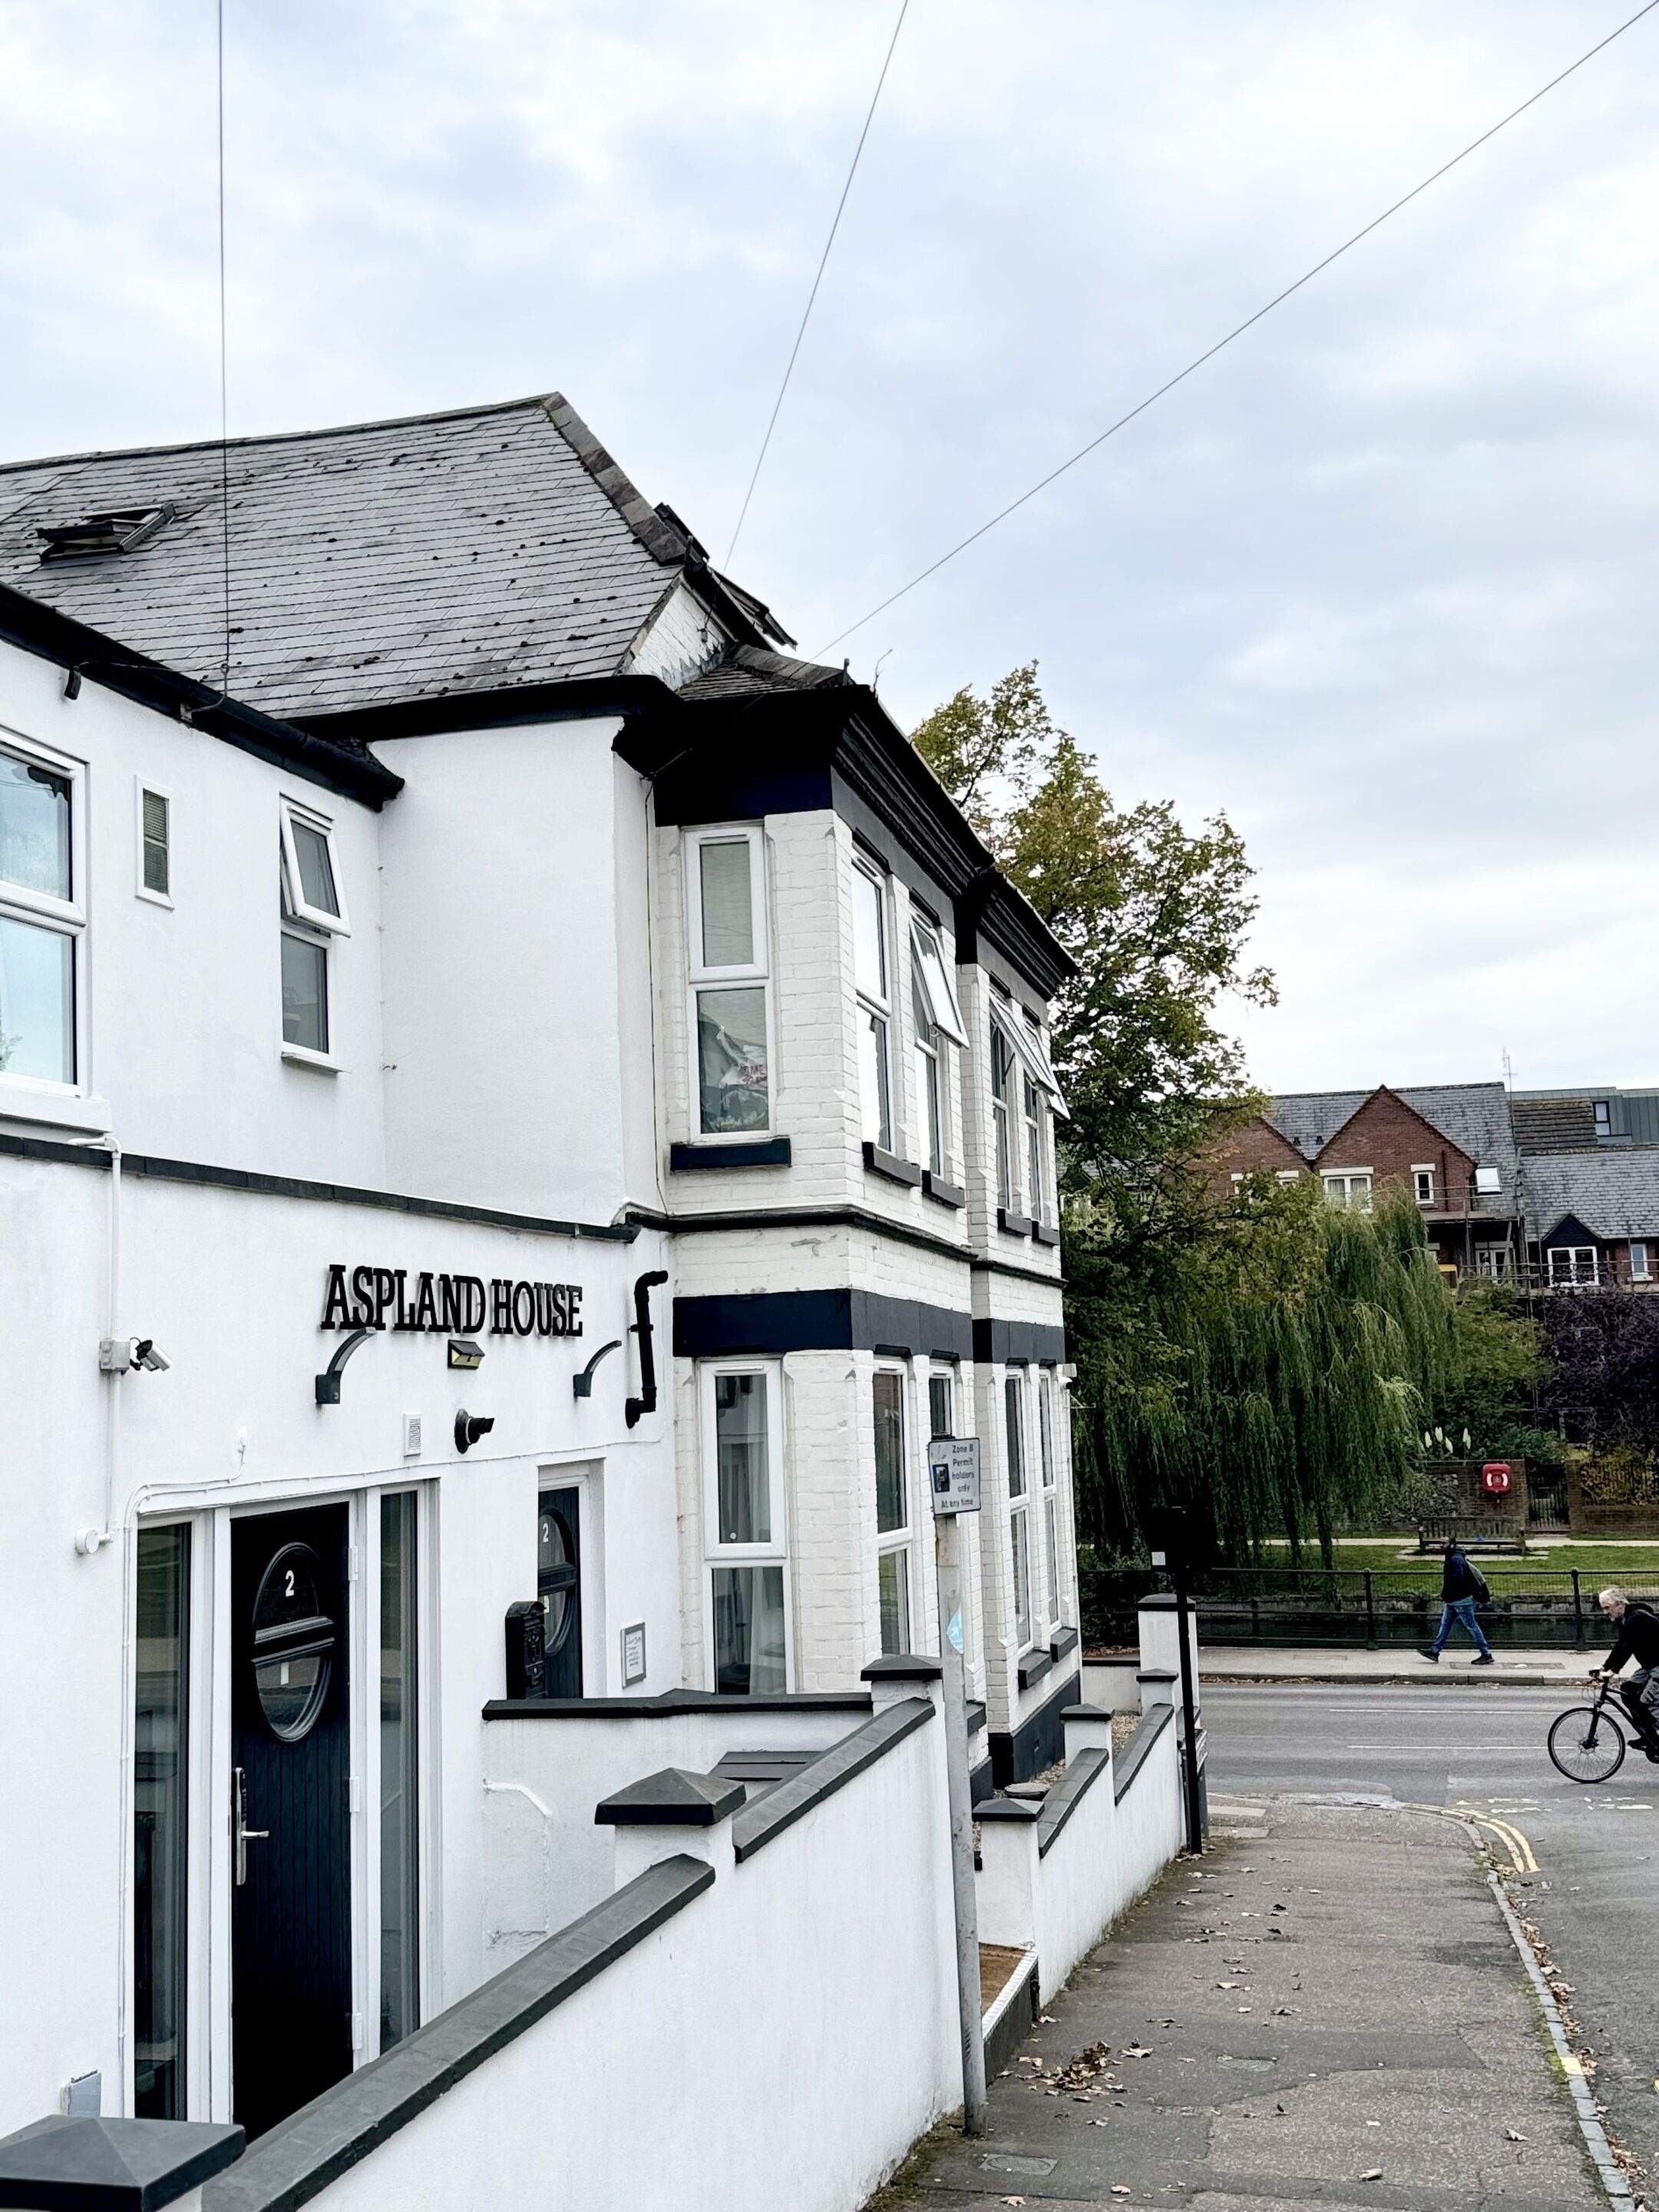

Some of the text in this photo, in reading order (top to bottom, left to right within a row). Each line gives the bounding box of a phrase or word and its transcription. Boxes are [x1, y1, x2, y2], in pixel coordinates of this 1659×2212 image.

[320, 1264, 583, 1337] ASPLAND HOUSE
[952, 1443, 973, 1453] Zone B
[953, 1458, 973, 1466] Permit
[952, 1471, 975, 1480] holders
[957, 1483, 970, 1493] only
[941, 1499, 949, 1509] At
[950, 1499, 960, 1509] any
[542, 1523, 549, 1543] 2
[285, 1569, 295, 1597] 2
